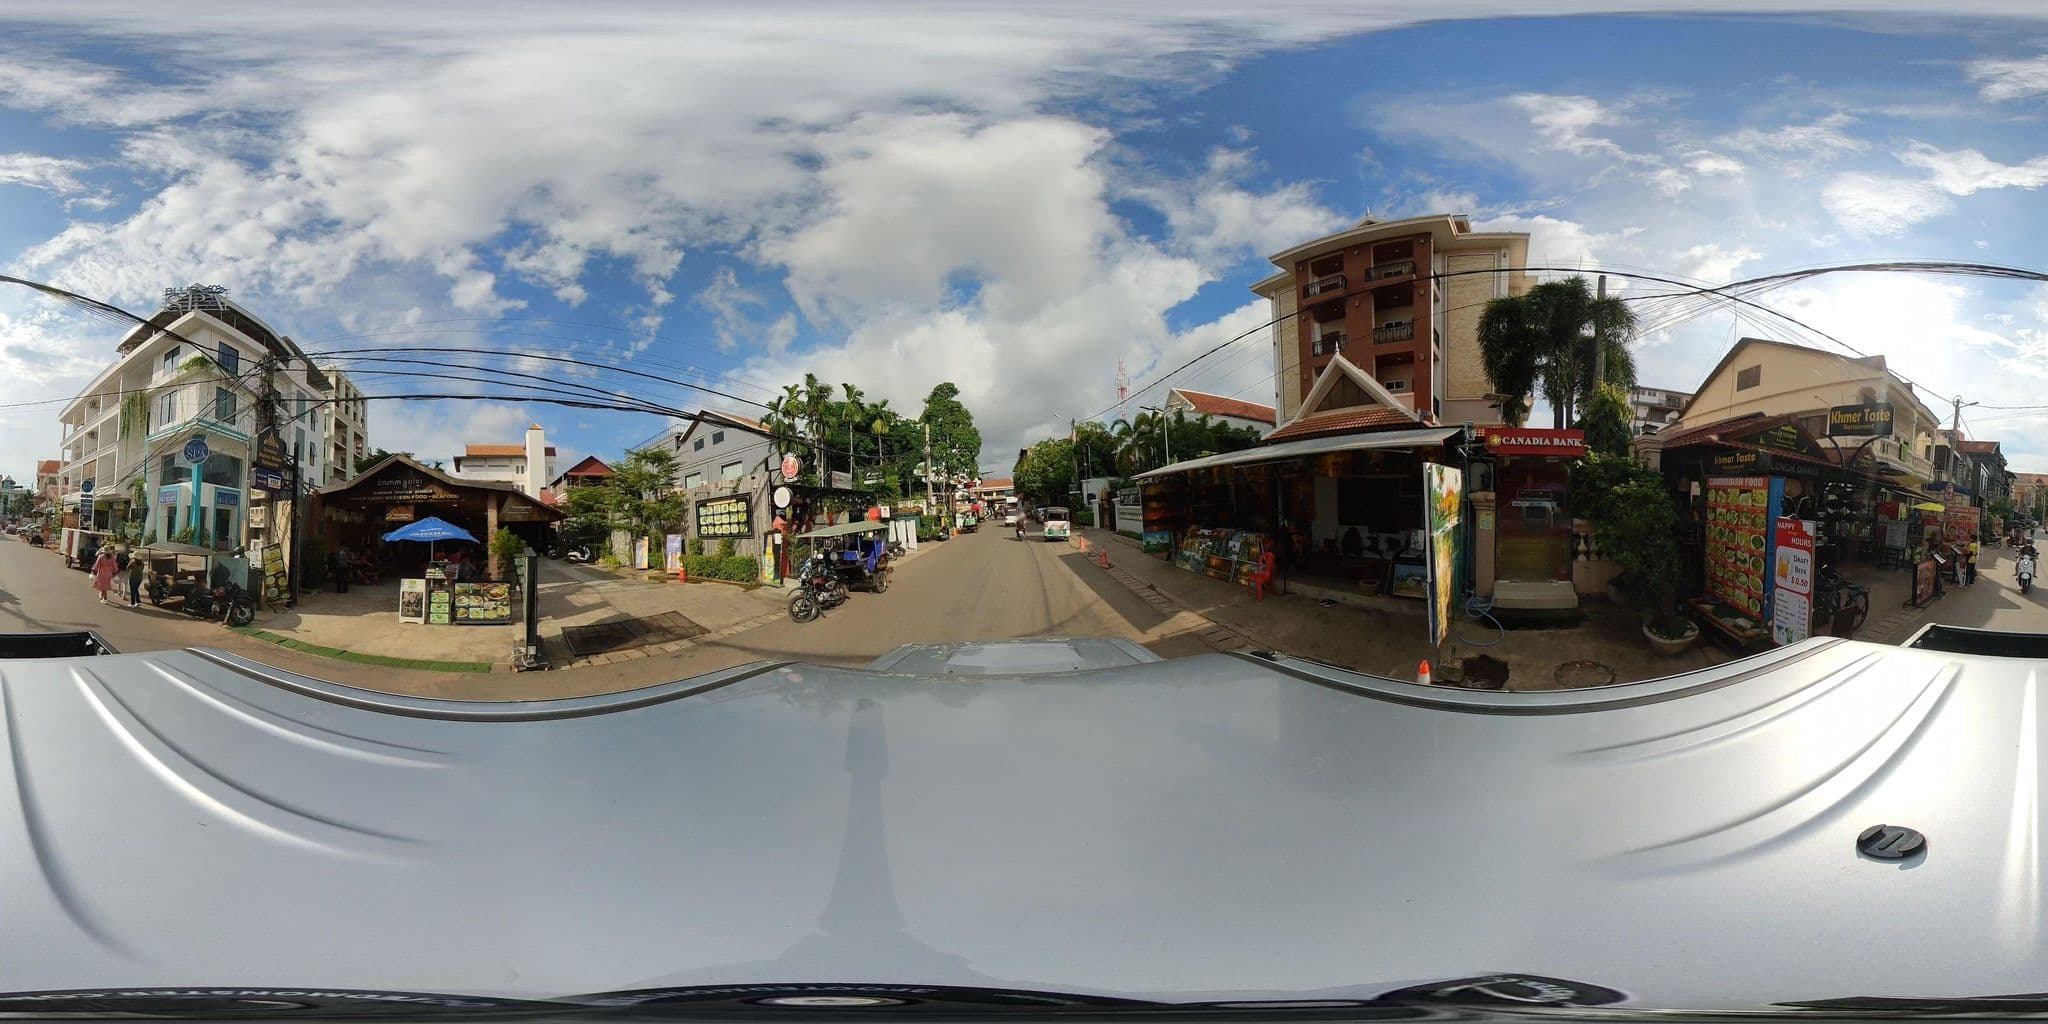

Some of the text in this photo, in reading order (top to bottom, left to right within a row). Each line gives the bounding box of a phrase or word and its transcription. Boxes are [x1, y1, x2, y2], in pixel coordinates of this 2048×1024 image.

[1831, 408, 1890, 424] Khmer Taste
[1502, 436, 1582, 447] CANADIA BANK
[186, 448, 206, 459] SPA
[1736, 452, 1756, 463] Taste
[1744, 478, 1763, 487] FOOD
[1777, 521, 1795, 531] HAPPY
[1791, 536, 1812, 548] HOURS
